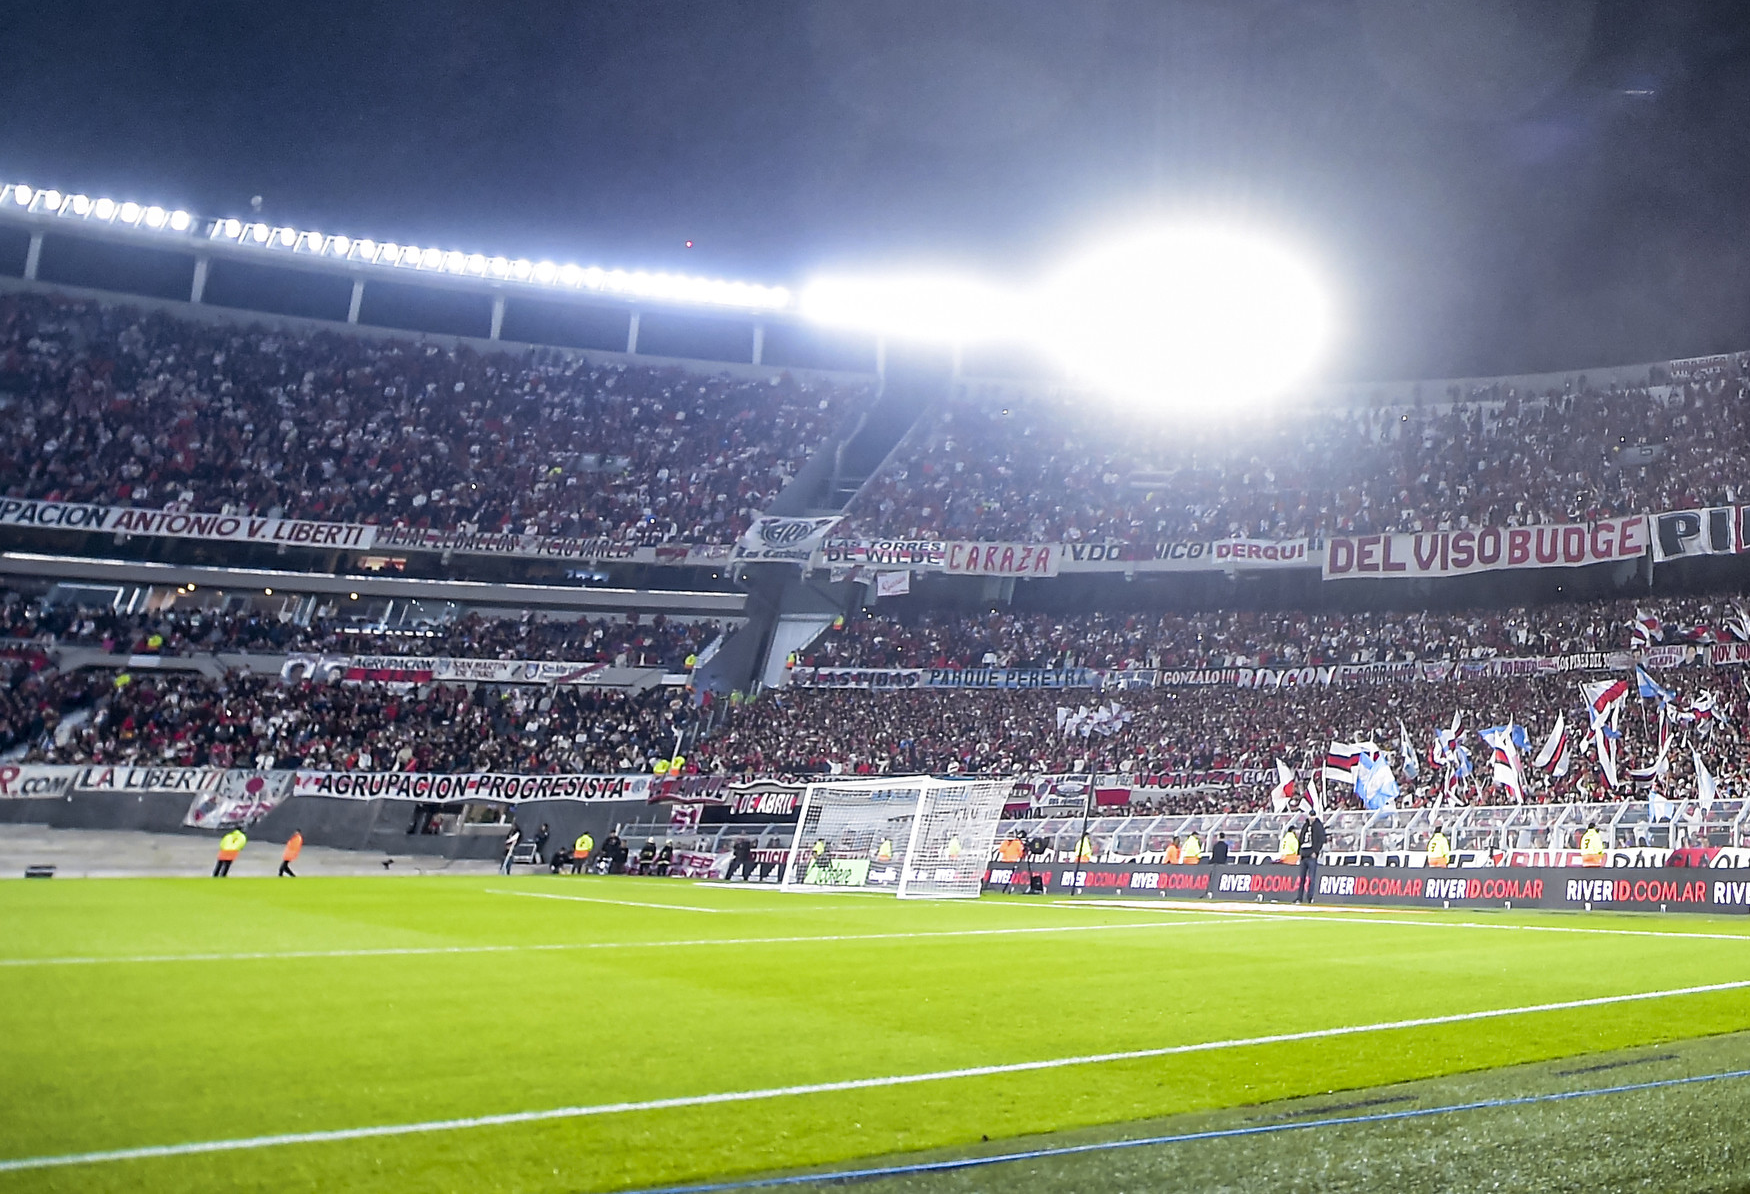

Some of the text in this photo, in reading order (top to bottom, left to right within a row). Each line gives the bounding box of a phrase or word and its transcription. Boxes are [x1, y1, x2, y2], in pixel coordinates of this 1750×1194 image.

[0, 500, 363, 546] PACION ANTONIO V. LIBERTI
[826, 549, 857, 562] DE
[865, 551, 940, 564] WILDE
[870, 541, 941, 552] TORRES
[1216, 543, 1304, 561] DERQUI
[1328, 516, 1643, 575] DEL VISO BUDGE
[949, 544, 1050, 573] CARAZA
[353, 657, 435, 670] AGRUPACION
[929, 669, 998, 686] PARQUE
[1005, 670, 1086, 688] PEREYRA
[1163, 669, 1234, 685] GONZALO!!!
[1237, 665, 1337, 688] RINCON
[80, 767, 115, 789] LA
[317, 774, 470, 800] AGRUPACION
[474, 774, 626, 799] PROGRESISTA
[1158, 772, 1236, 789] CARAZA
[755, 792, 796, 815] ABRIL
[1319, 875, 1423, 897] RIVERID.COM.AR
[1424, 877, 1544, 901] RIVERID.COM.AR
[1565, 878, 1708, 904] RIVERID.COM.AR
